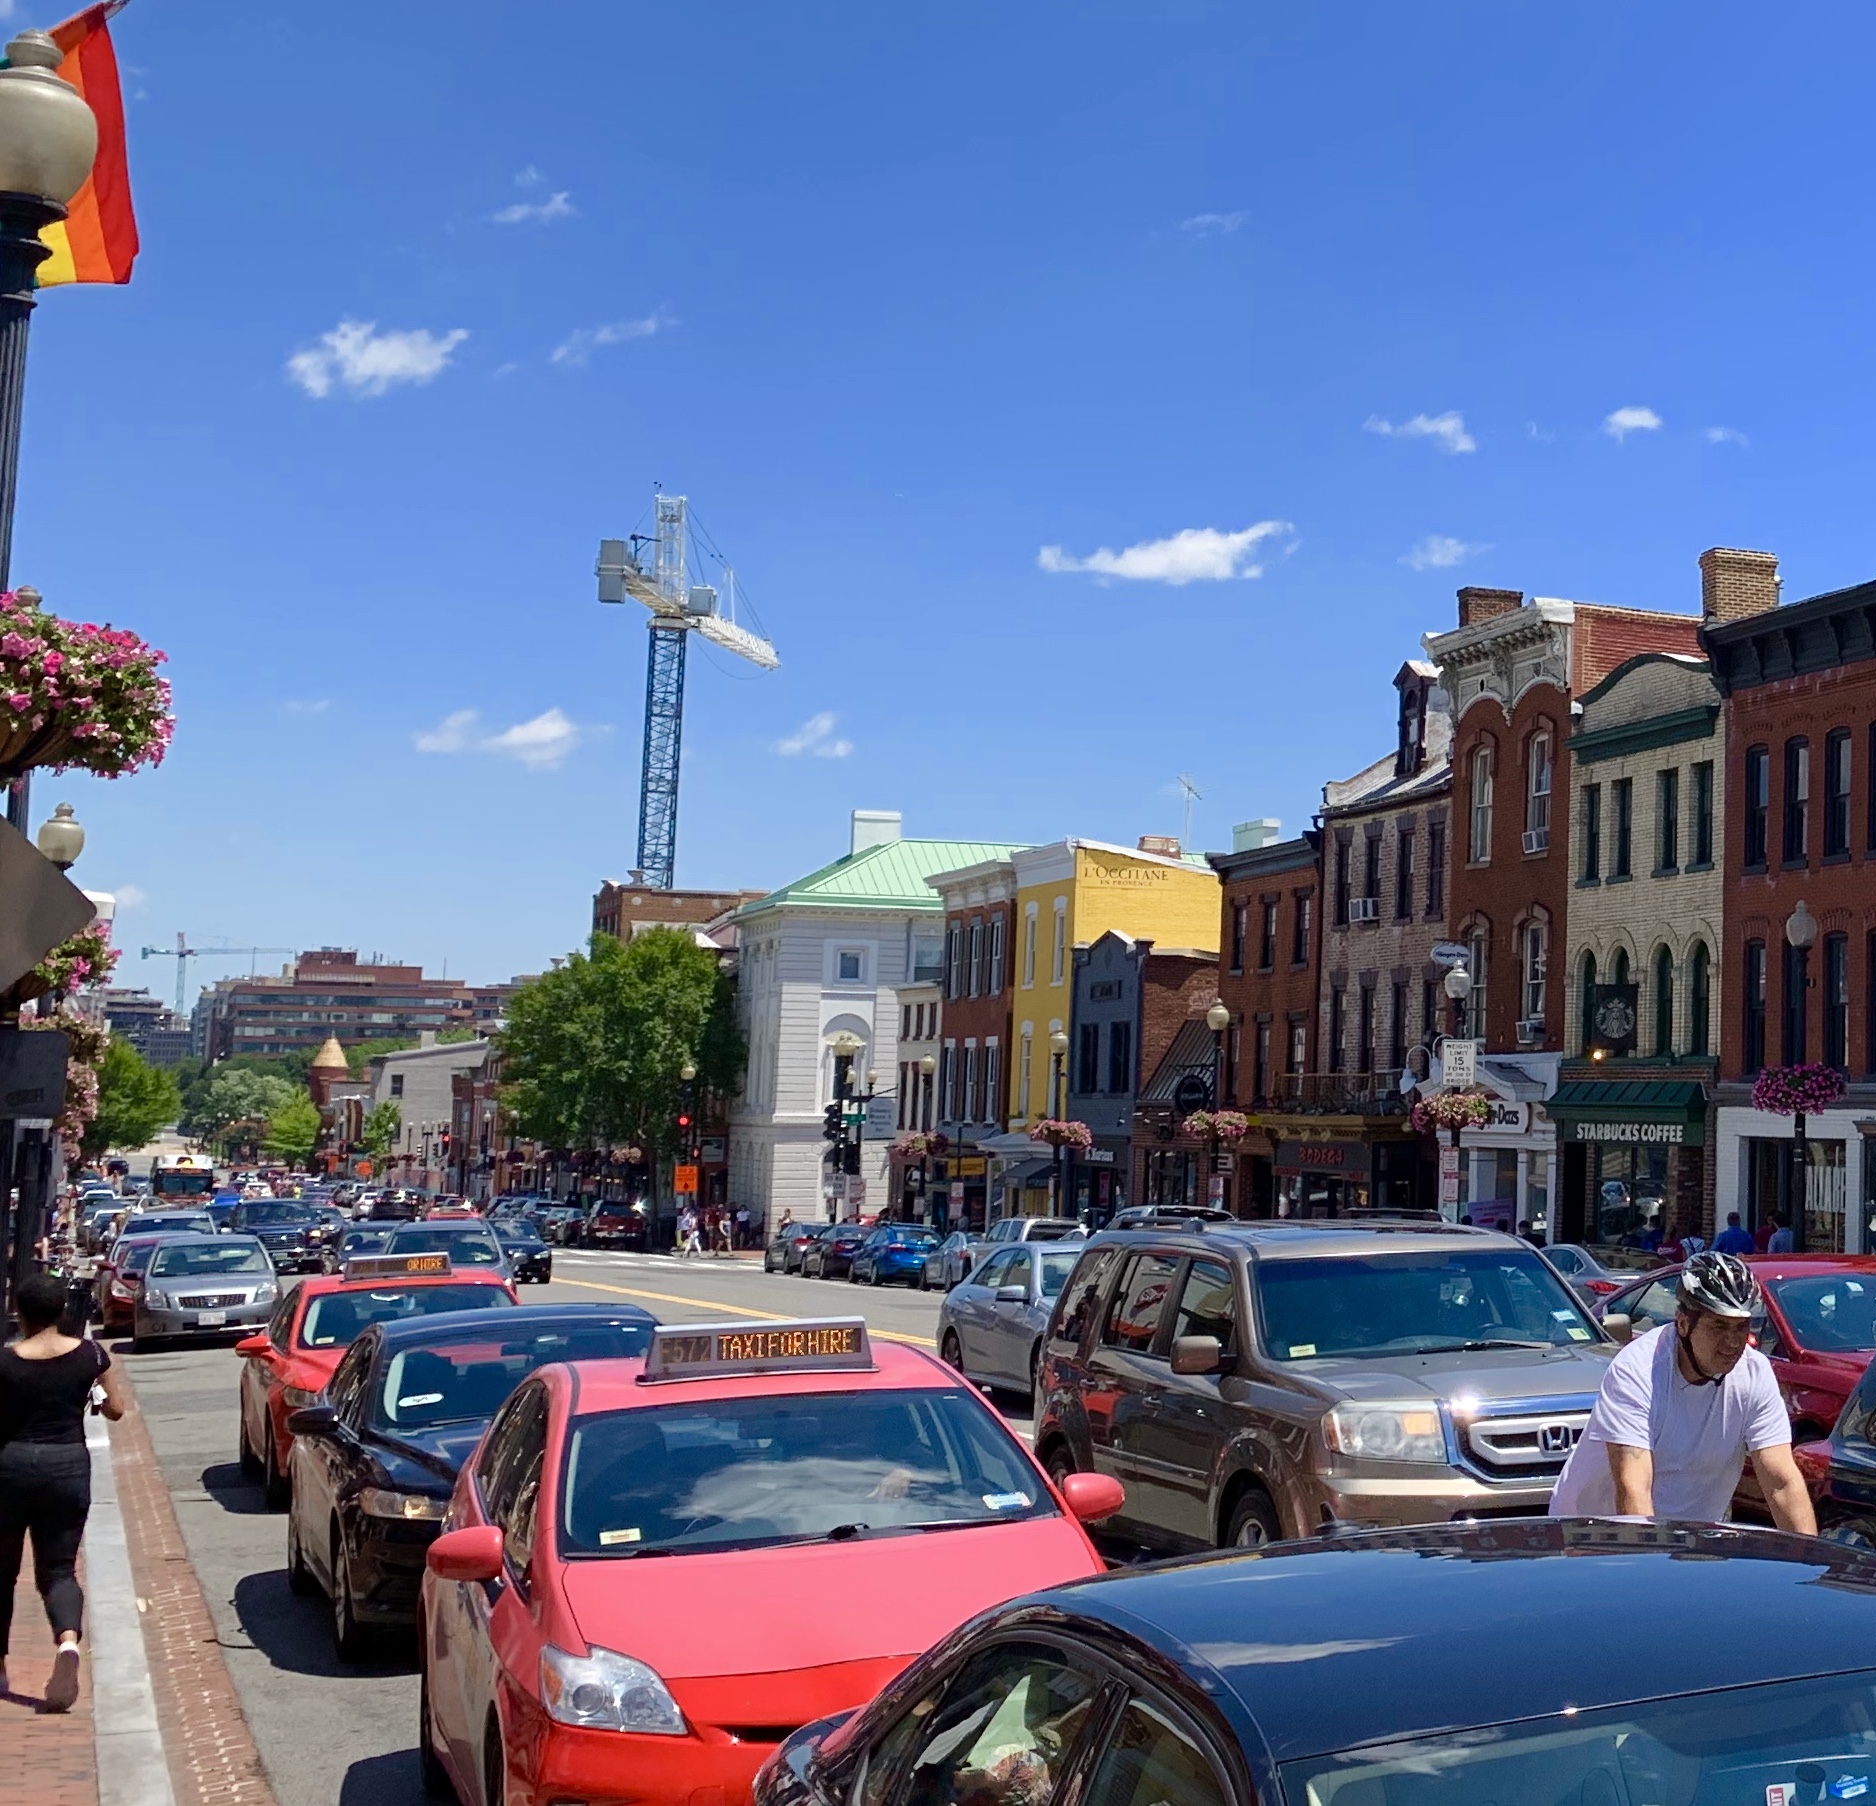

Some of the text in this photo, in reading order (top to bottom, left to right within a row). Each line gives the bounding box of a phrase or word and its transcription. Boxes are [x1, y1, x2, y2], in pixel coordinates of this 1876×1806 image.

[1454, 1056, 1464, 1065] 15
[1576, 1122, 1683, 1142] STARBUCKS COFFEE
[1300, 1147, 1344, 1165] BODEGA
